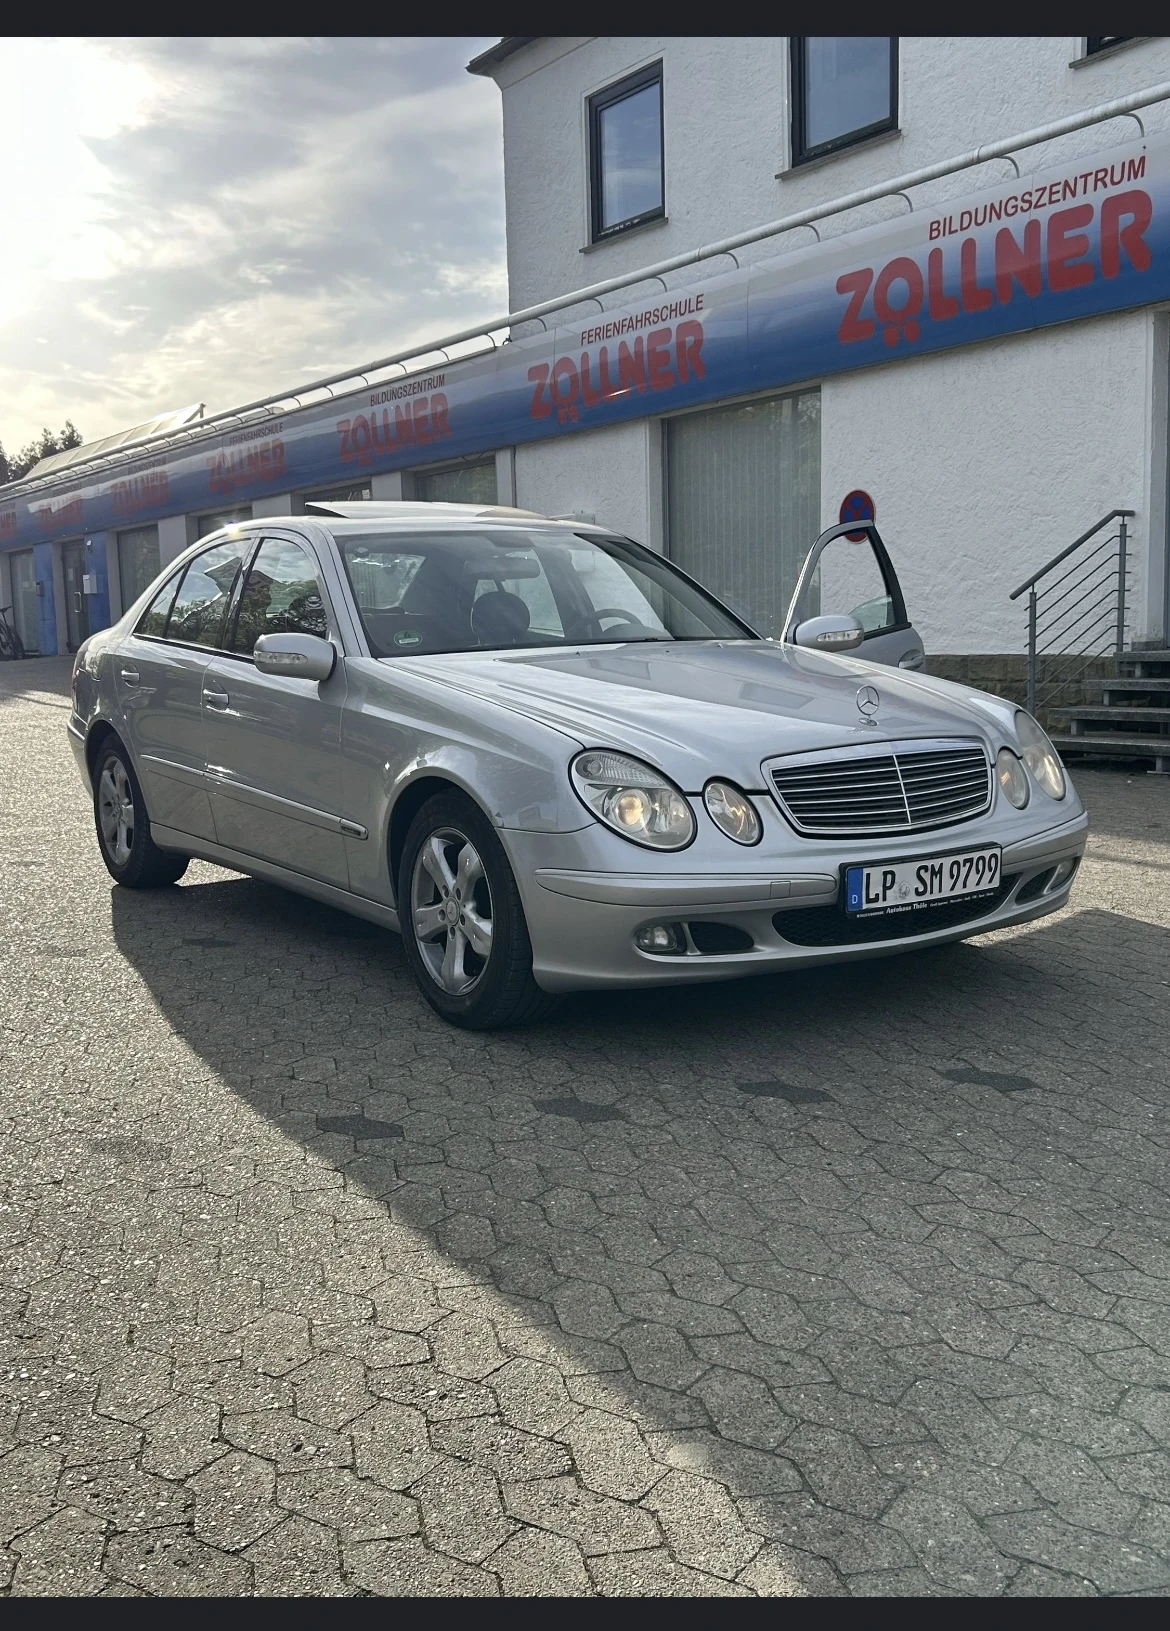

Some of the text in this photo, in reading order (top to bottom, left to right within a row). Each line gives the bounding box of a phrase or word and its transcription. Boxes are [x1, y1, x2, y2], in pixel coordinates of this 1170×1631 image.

[928, 155, 1147, 242] BILDUNGSZENTRUM
[580, 293, 705, 347] FERIENFAHRSCHULE
[370, 373, 446, 408] BILDUNGSZENTRUM
[851, 894, 858, 905] D
[865, 852, 999, 905] LP SM 9799
[885, 904, 912, 914] Autohaus
